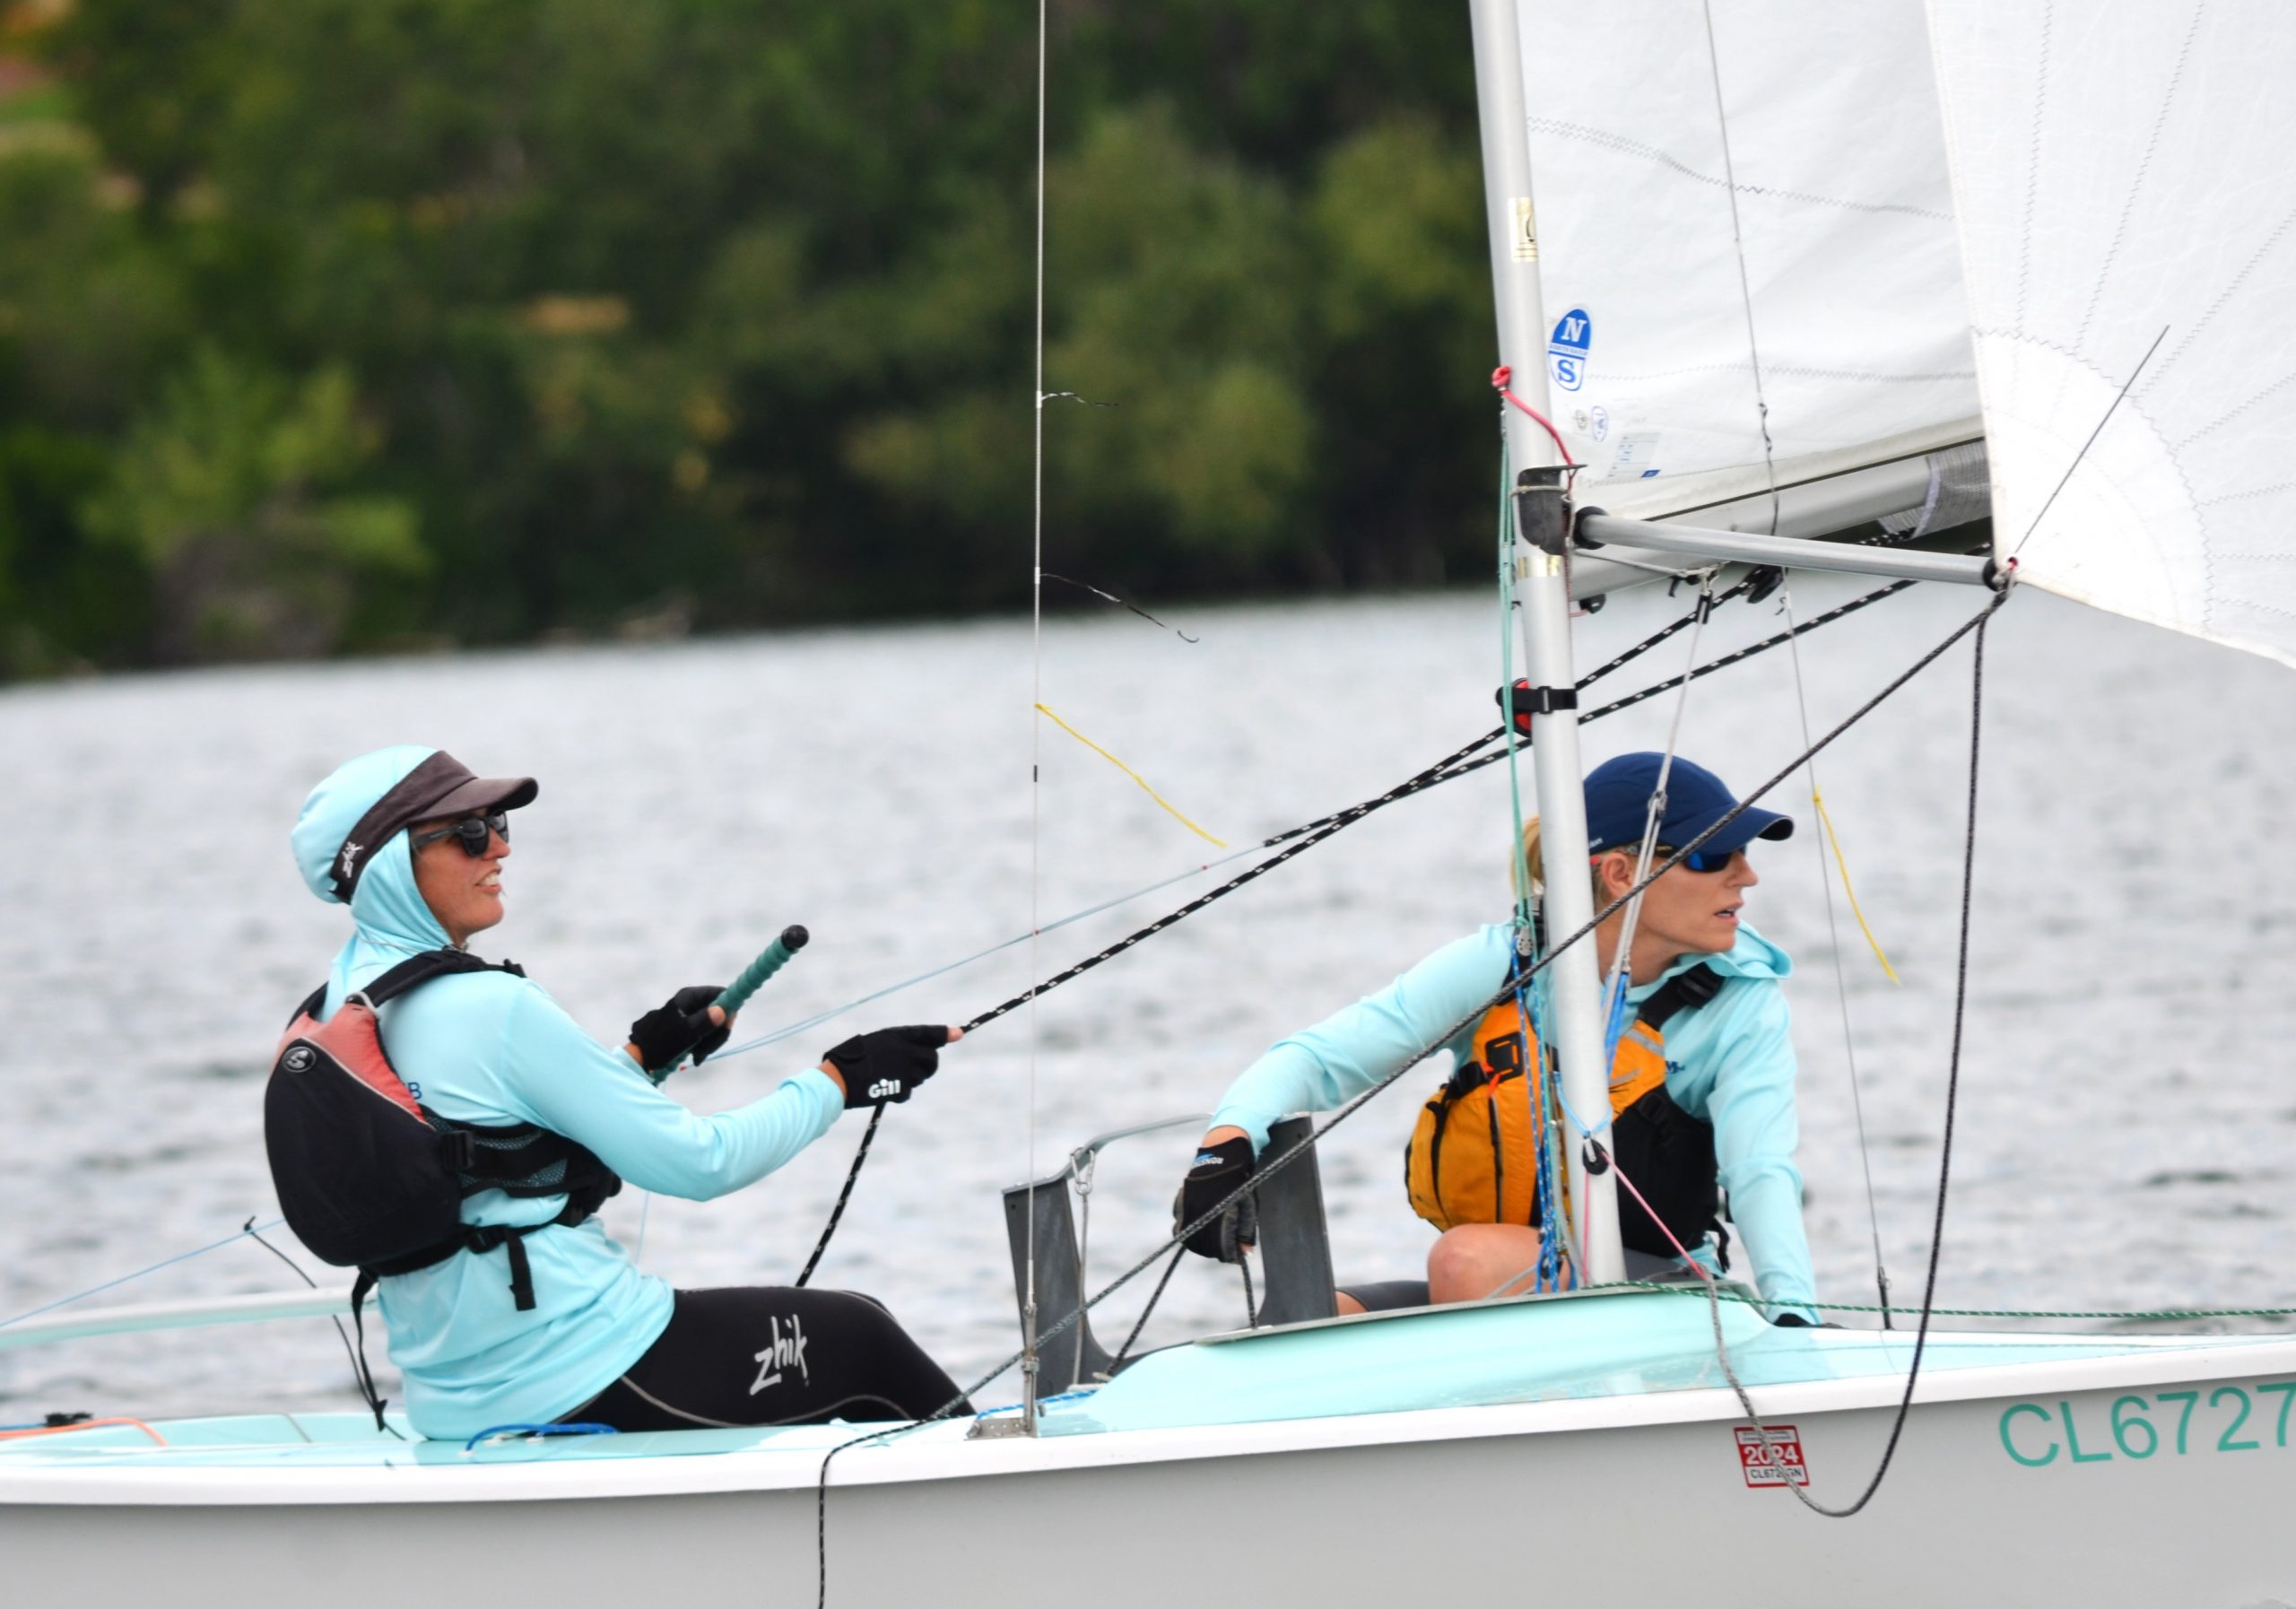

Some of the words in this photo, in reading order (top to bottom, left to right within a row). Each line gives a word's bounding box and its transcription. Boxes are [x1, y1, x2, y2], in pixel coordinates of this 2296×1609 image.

[1561, 317, 1587, 343] N
[1558, 359, 1577, 383] S
[868, 1078, 900, 1099] Gill
[749, 1313, 809, 1396] zhik
[1999, 1381, 2296, 1467] CL6727
[1744, 1445, 1798, 1465] 2024
